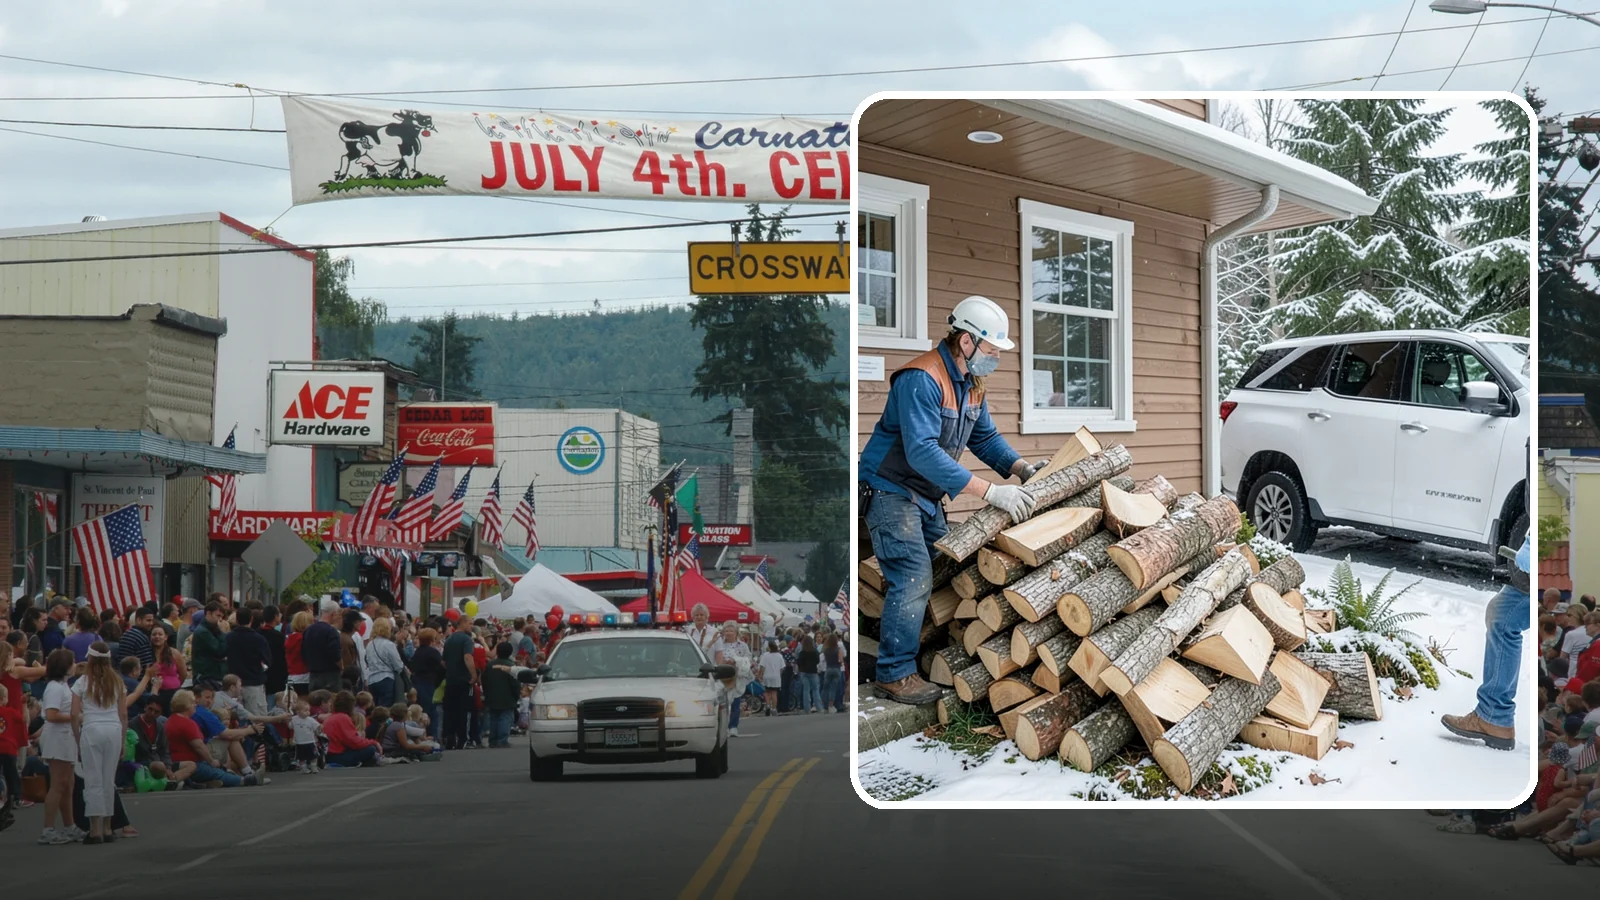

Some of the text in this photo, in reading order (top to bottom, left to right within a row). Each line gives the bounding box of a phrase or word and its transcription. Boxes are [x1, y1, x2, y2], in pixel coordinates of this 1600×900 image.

[481, 141, 606, 193] JULY
[632, 149, 746, 198] 4th.
[697, 254, 850, 280] CROSSWA
[283, 380, 373, 420] ACE
[406, 409, 485, 422] CEDAR LOG
[284, 421, 371, 436] Hardware
[416, 428, 478, 447] Coca-Cola
[353, 467, 384, 480] Simpl
[83, 485, 155, 495] St. Vincent de Paul
[80, 503, 154, 522] THT
[212, 515, 331, 536] HARDARE
[688, 526, 741, 535] CRNATION
[699, 535, 730, 543] GLASS
